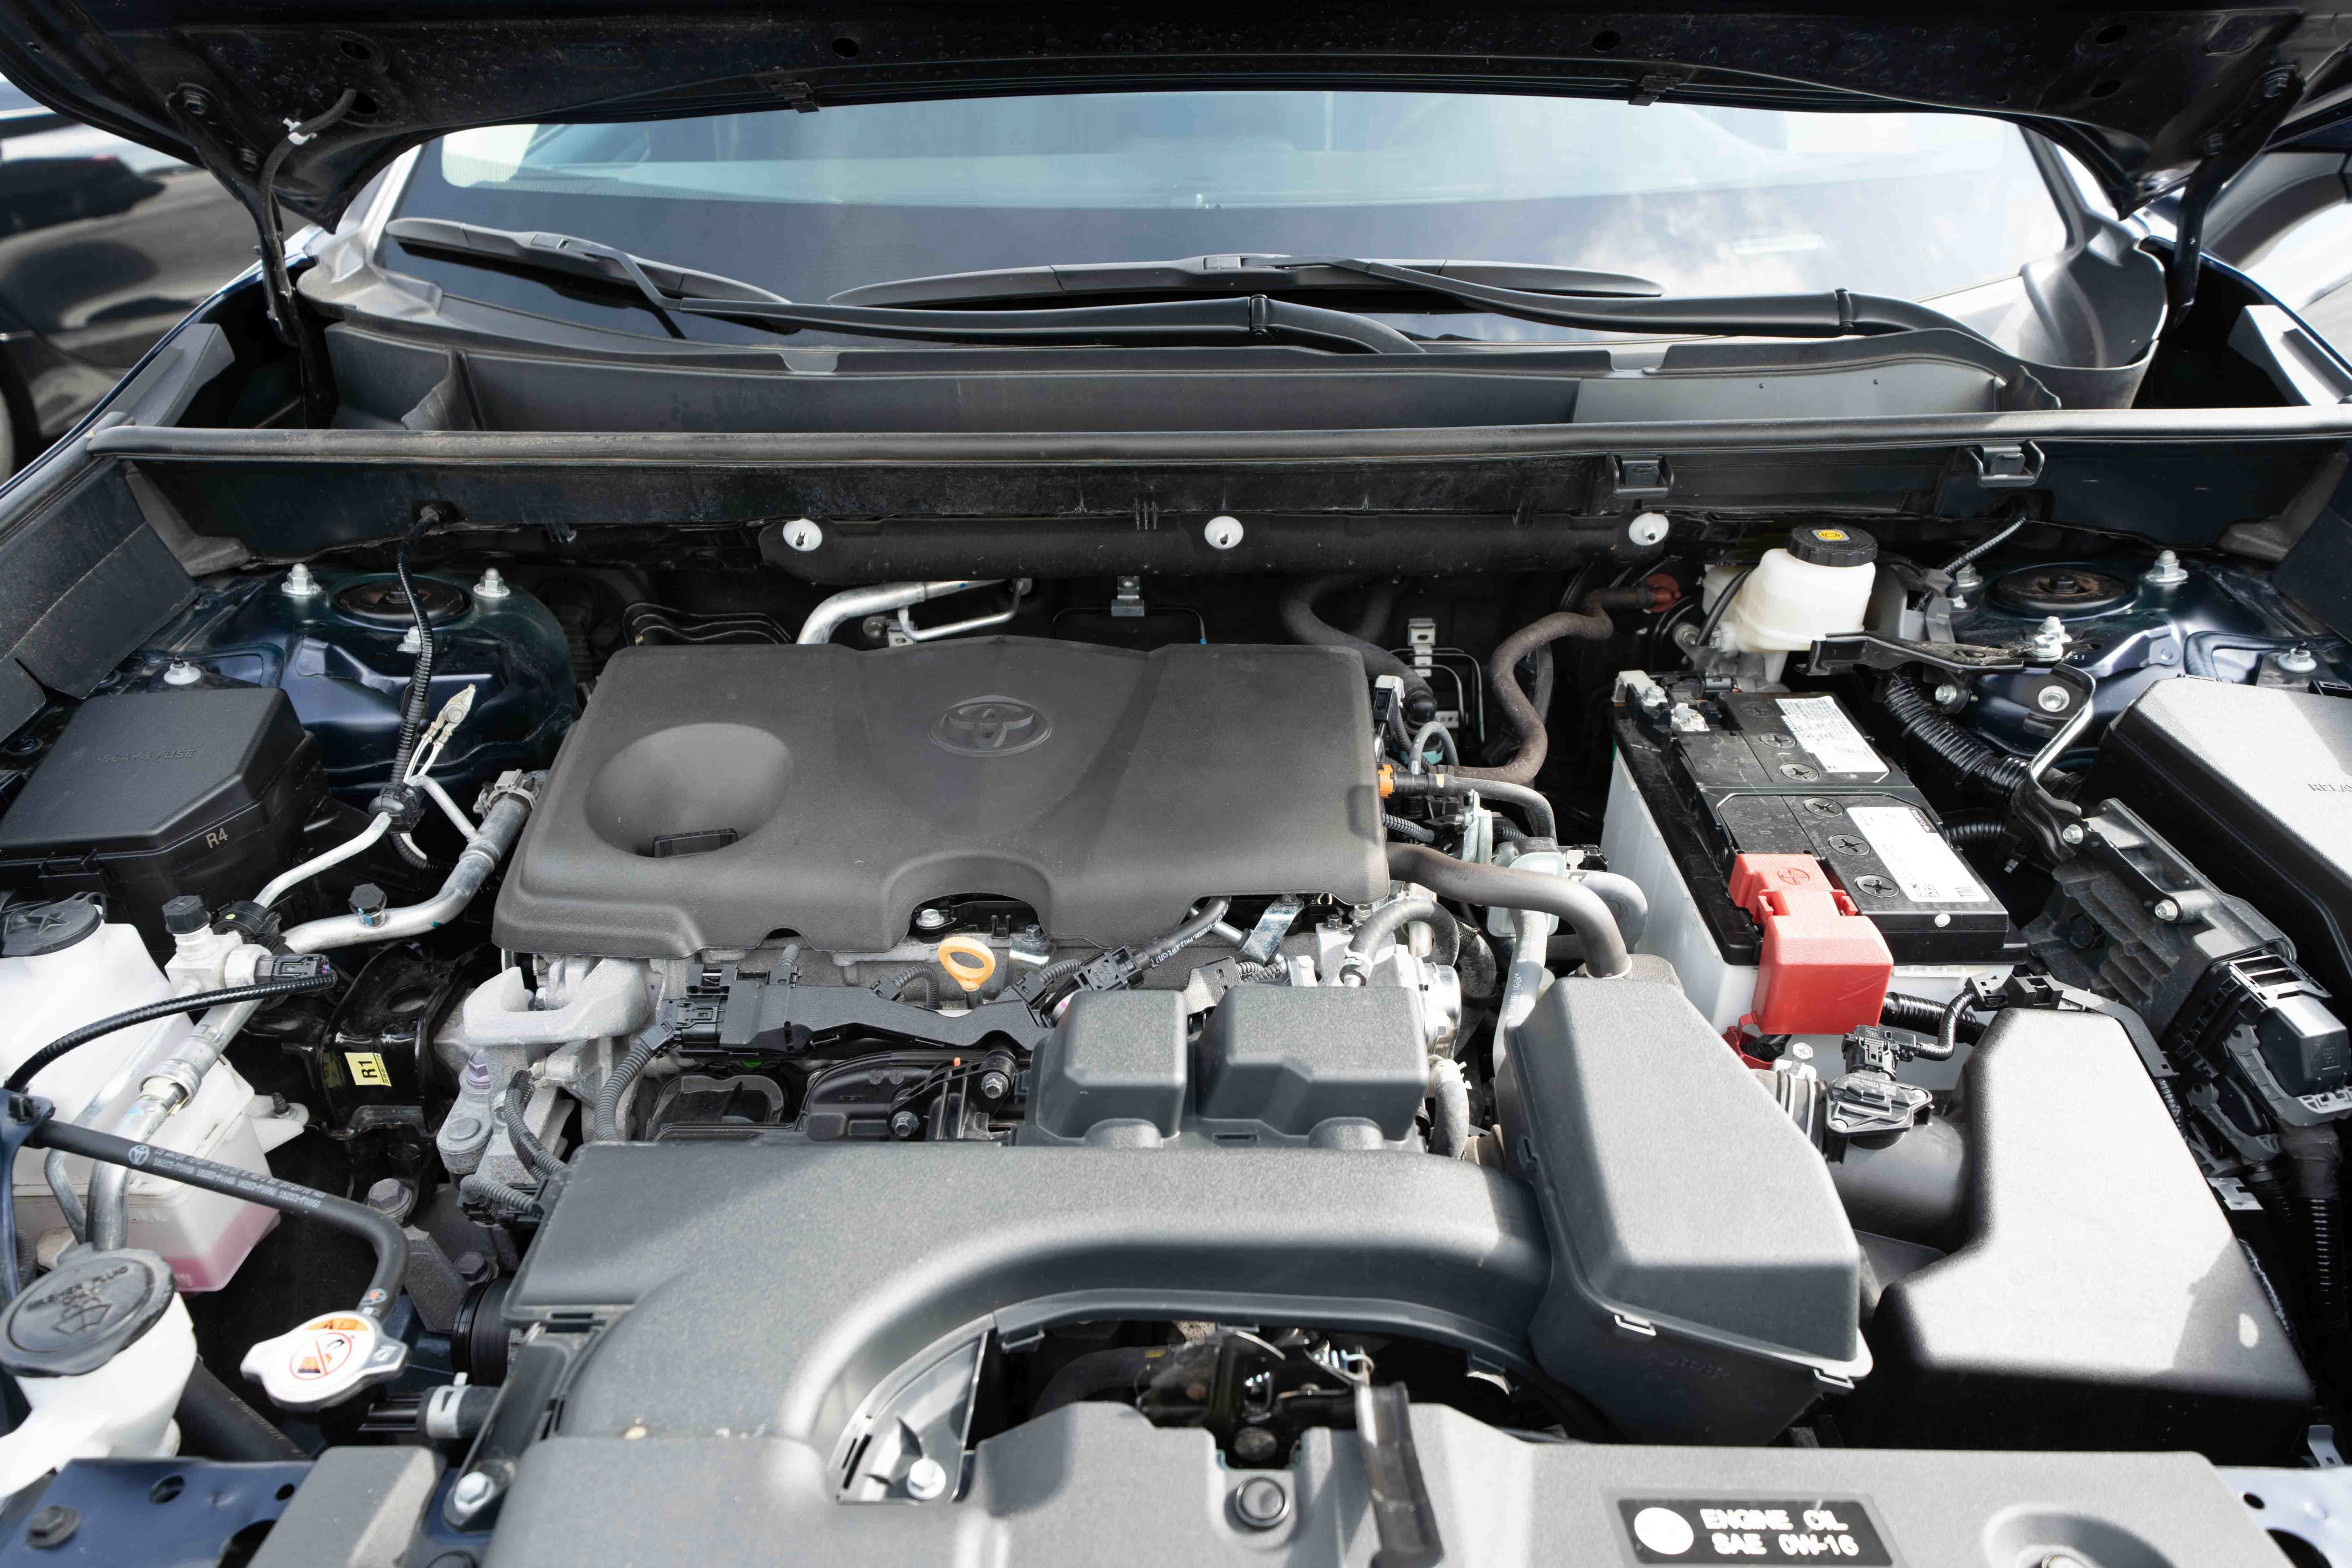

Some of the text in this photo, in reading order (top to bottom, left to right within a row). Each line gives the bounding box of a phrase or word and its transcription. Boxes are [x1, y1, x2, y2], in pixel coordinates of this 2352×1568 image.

[156, 749, 196, 760] FUSE
[205, 827, 228, 849] R4
[358, 1061, 378, 1078] R1
[91, 1265, 128, 1285] FLUID
[1700, 1509, 1849, 1531] ENGINE OIL
[1711, 1533, 1859, 1556] SAE 0W-16
